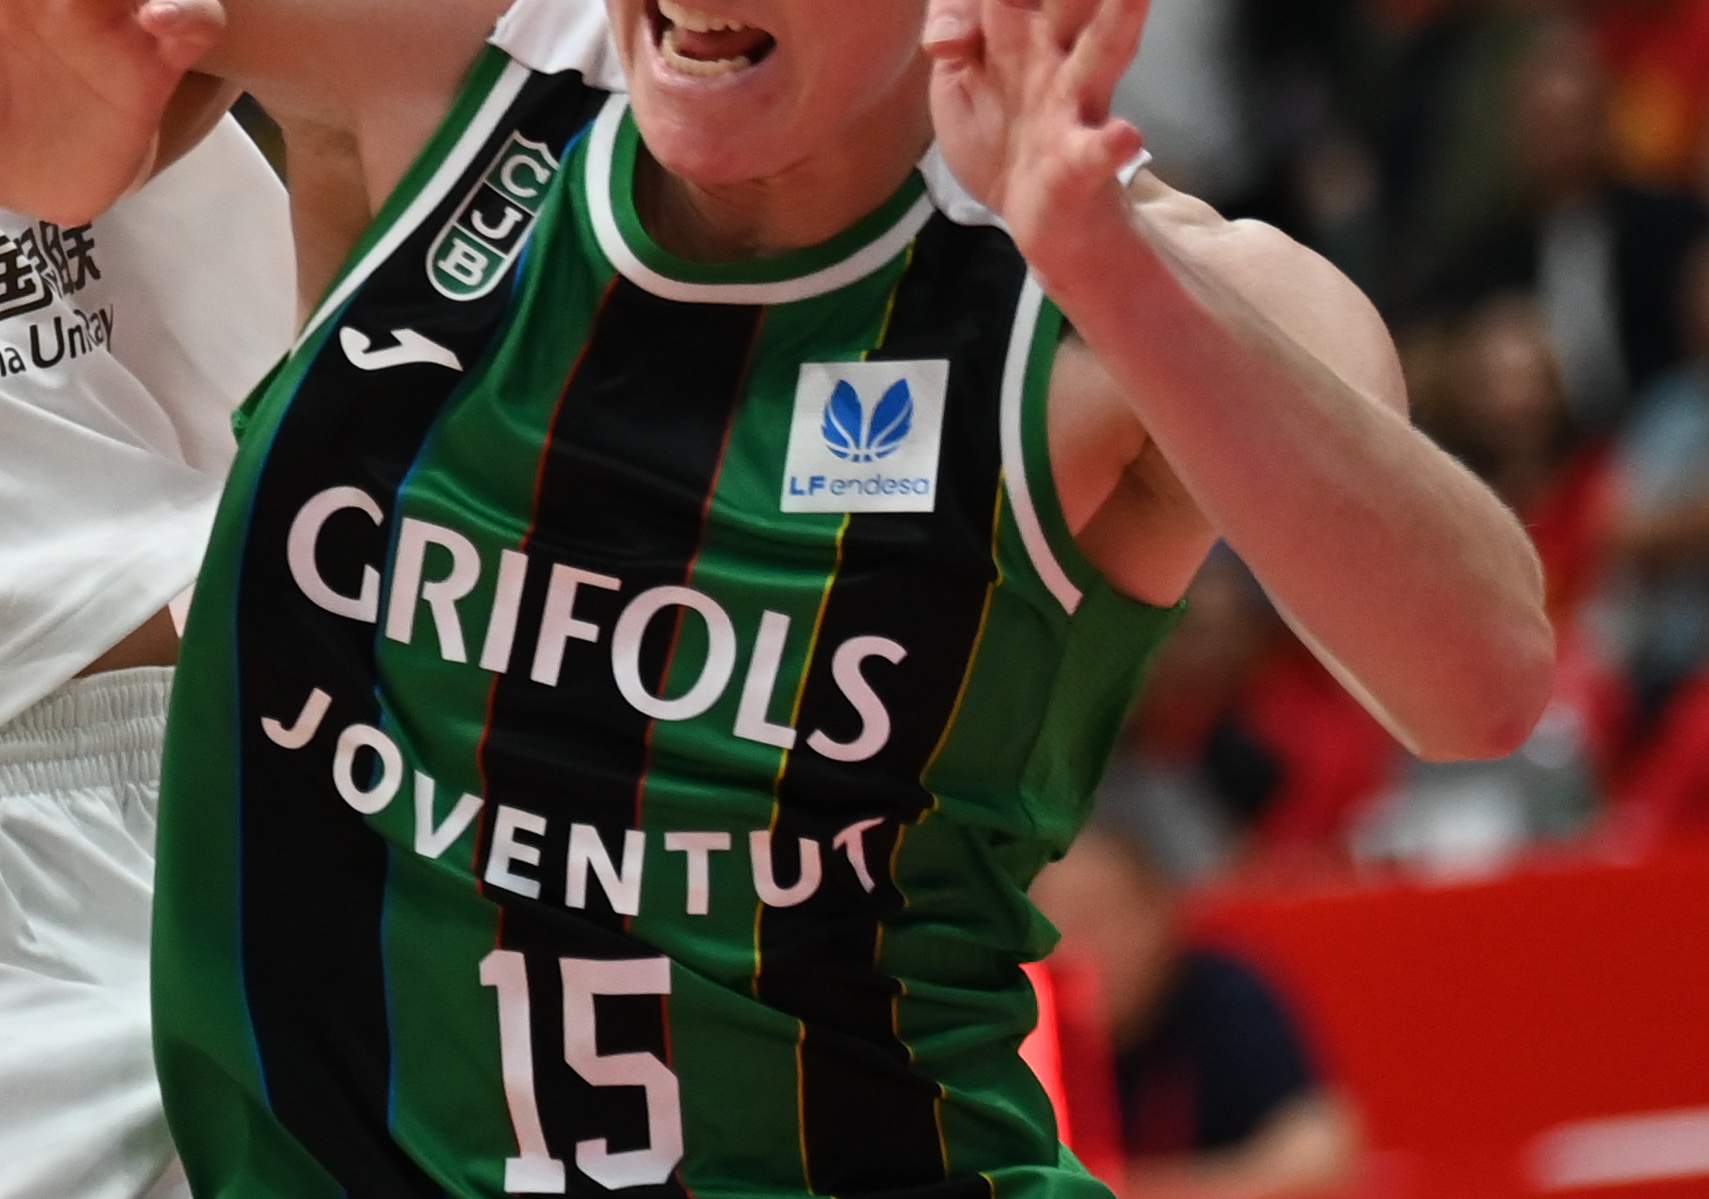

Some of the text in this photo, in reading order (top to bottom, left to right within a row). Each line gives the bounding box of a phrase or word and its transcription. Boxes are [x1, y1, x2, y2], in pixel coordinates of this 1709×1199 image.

[789, 474, 931, 496] LF endesa
[286, 484, 909, 763] GRIFOLS
[260, 687, 886, 916] JOVENTUT
[478, 948, 685, 1195] 15
